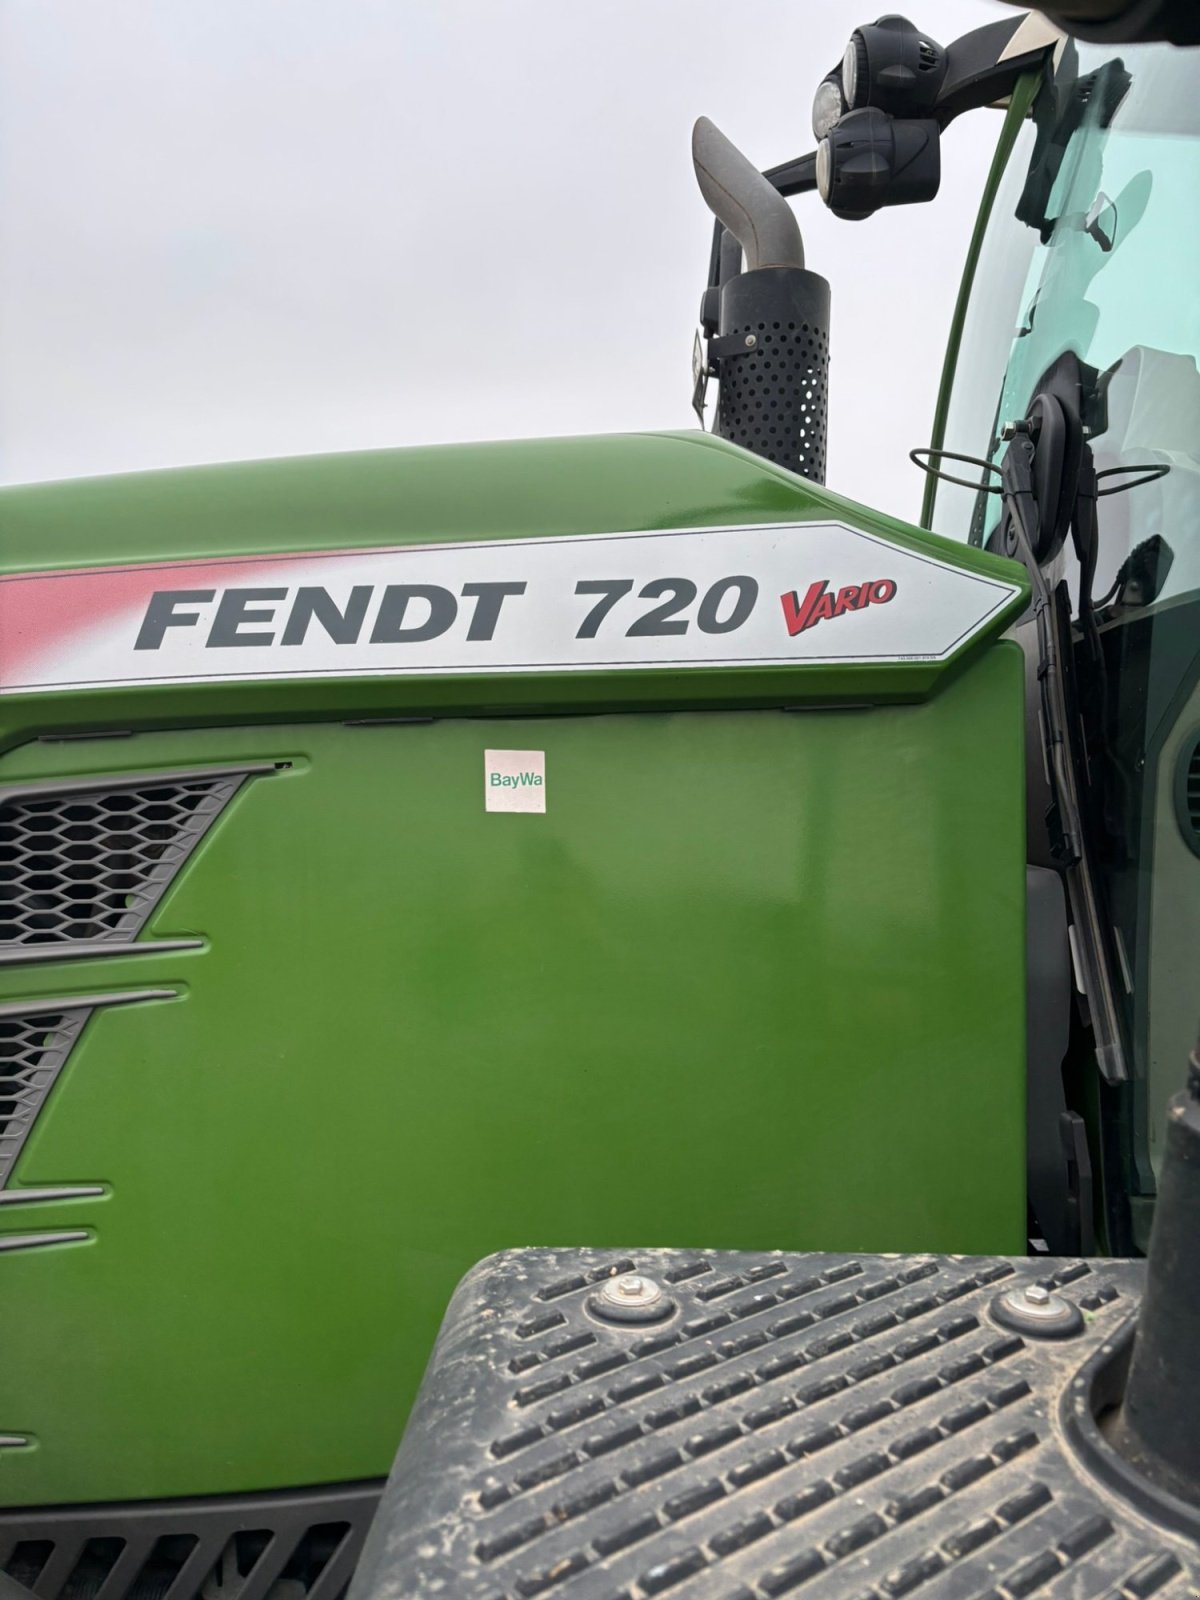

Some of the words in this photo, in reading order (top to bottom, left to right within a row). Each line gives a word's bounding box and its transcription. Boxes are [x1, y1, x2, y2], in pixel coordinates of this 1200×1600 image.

[133, 581, 527, 650] FENDT
[574, 575, 759, 639] 720
[780, 579, 897, 637] VARIO
[490, 772, 543, 789] BayWa
